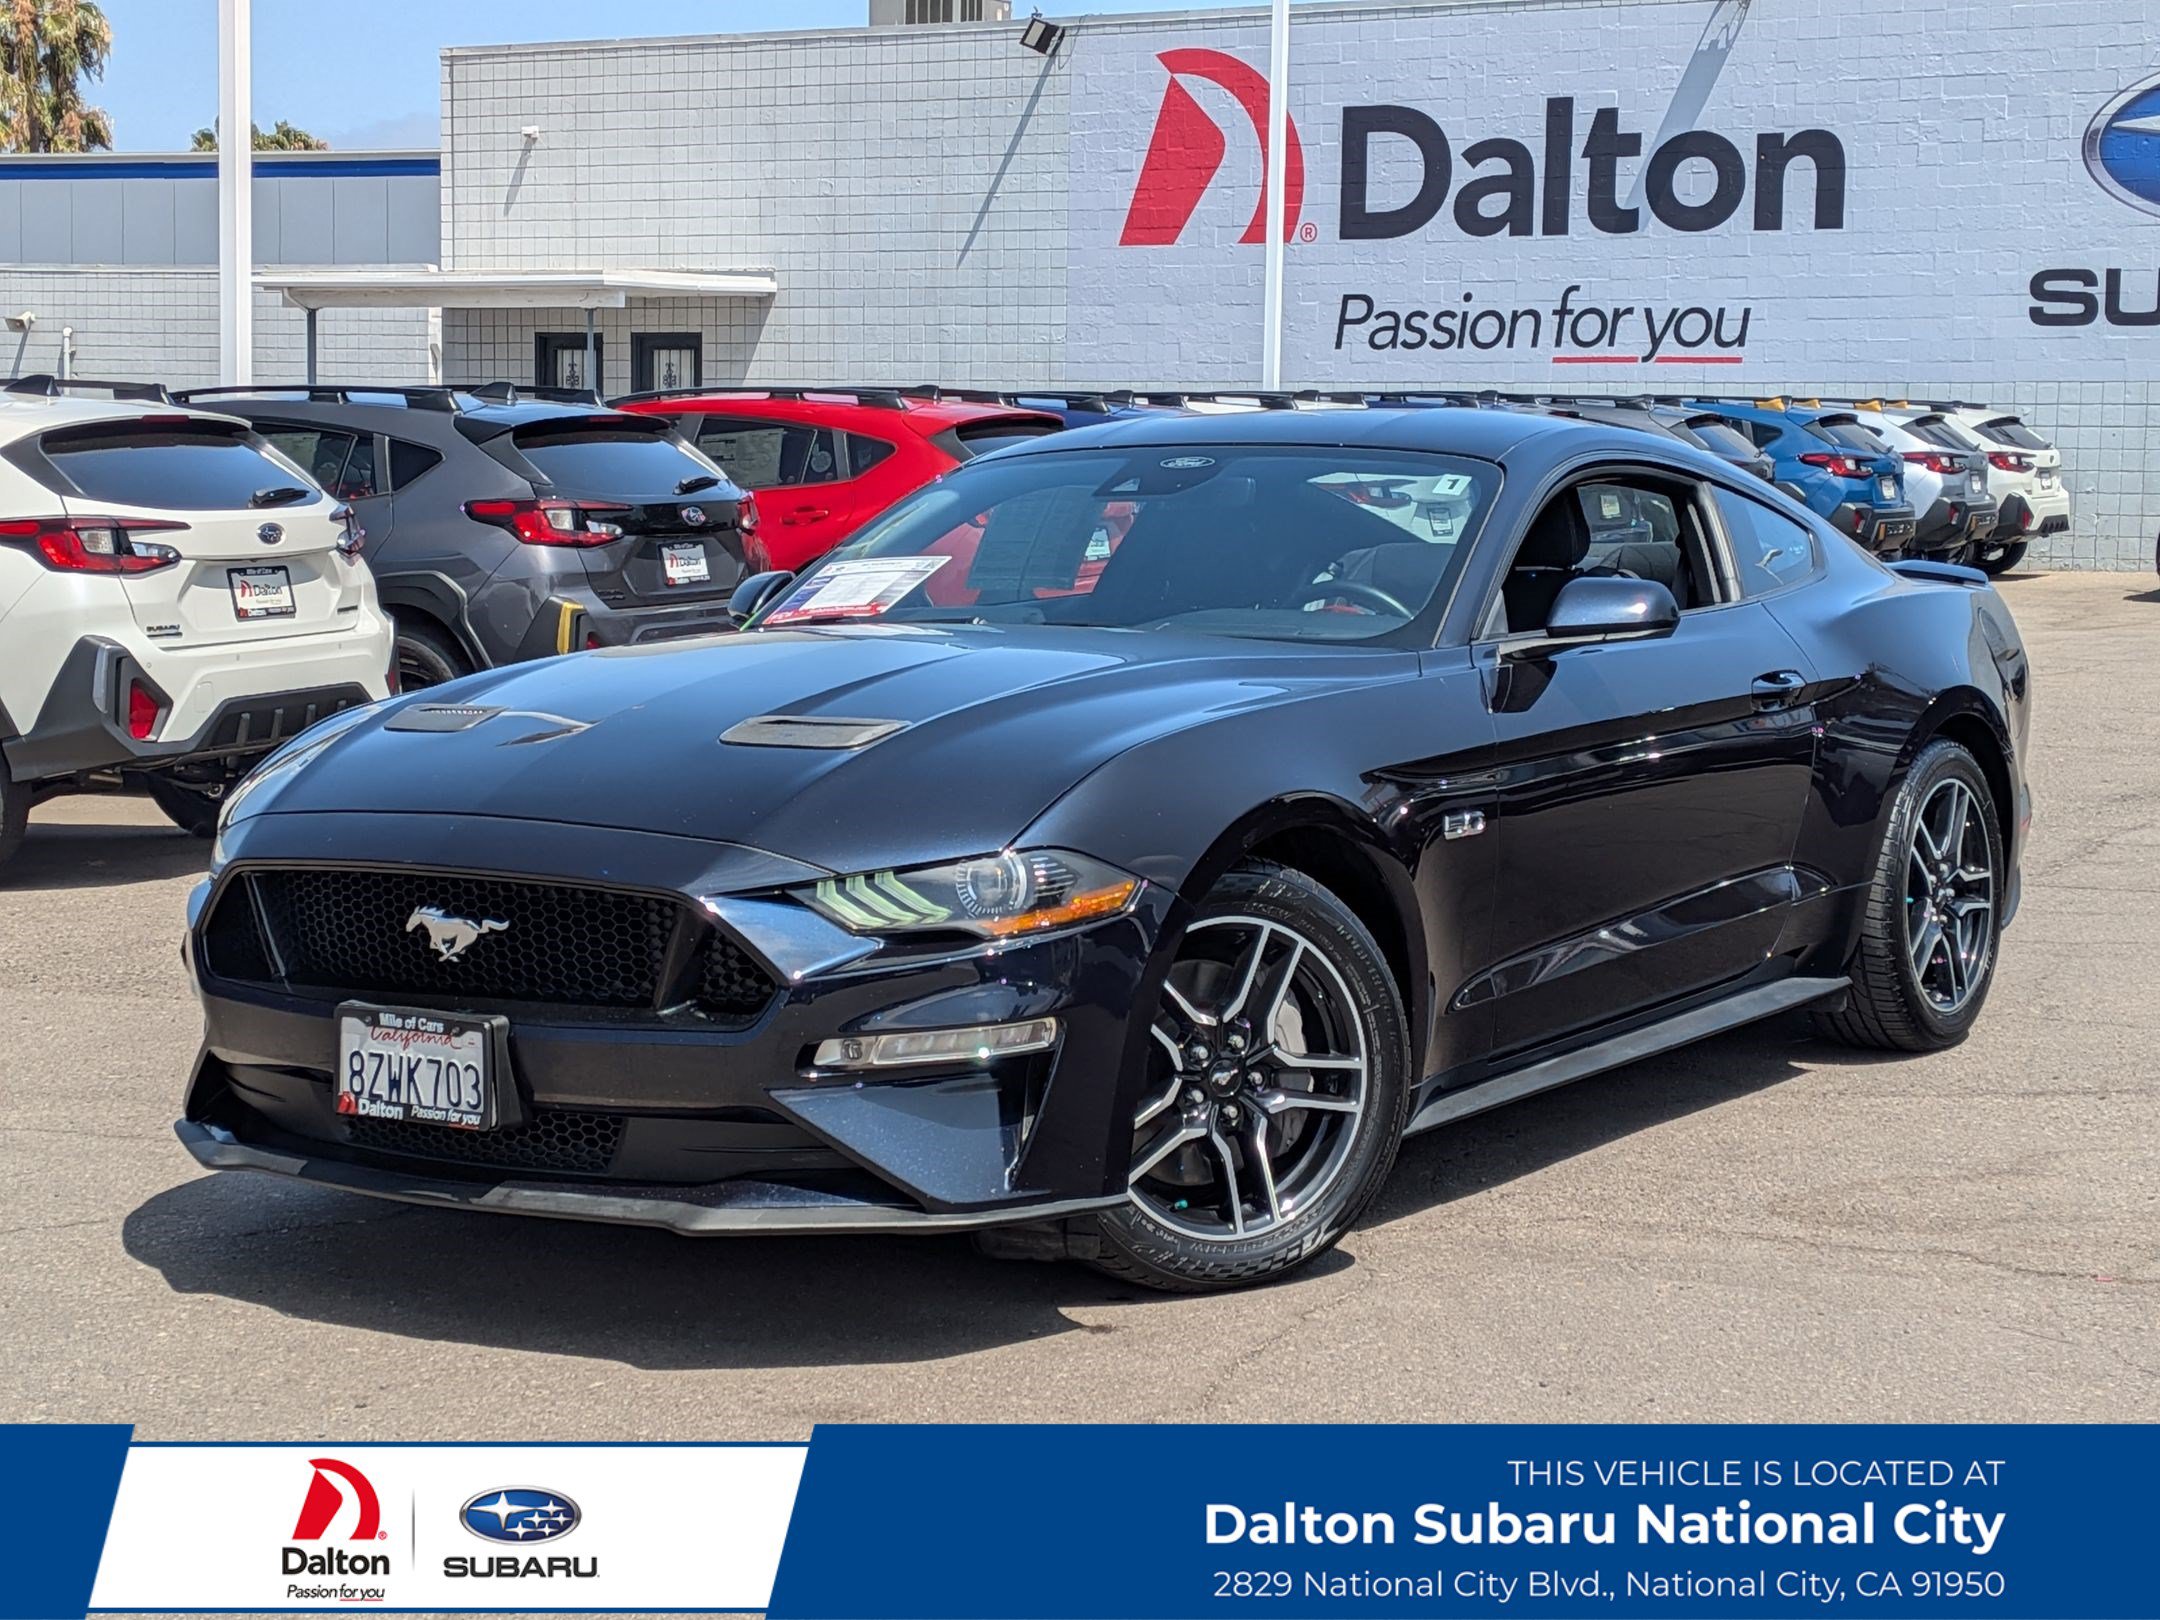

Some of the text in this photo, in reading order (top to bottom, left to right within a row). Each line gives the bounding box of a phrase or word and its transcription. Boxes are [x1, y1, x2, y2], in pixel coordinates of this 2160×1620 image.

[1340, 97, 1845, 239] Dalton
[1335, 285, 1751, 363] Passion for you
[370, 1025, 462, 1050] California
[379, 1013, 444, 1032] Mile of Cars
[349, 1050, 483, 1110] 8ZWK703
[358, 1099, 481, 1126] Dalton Passion for you
